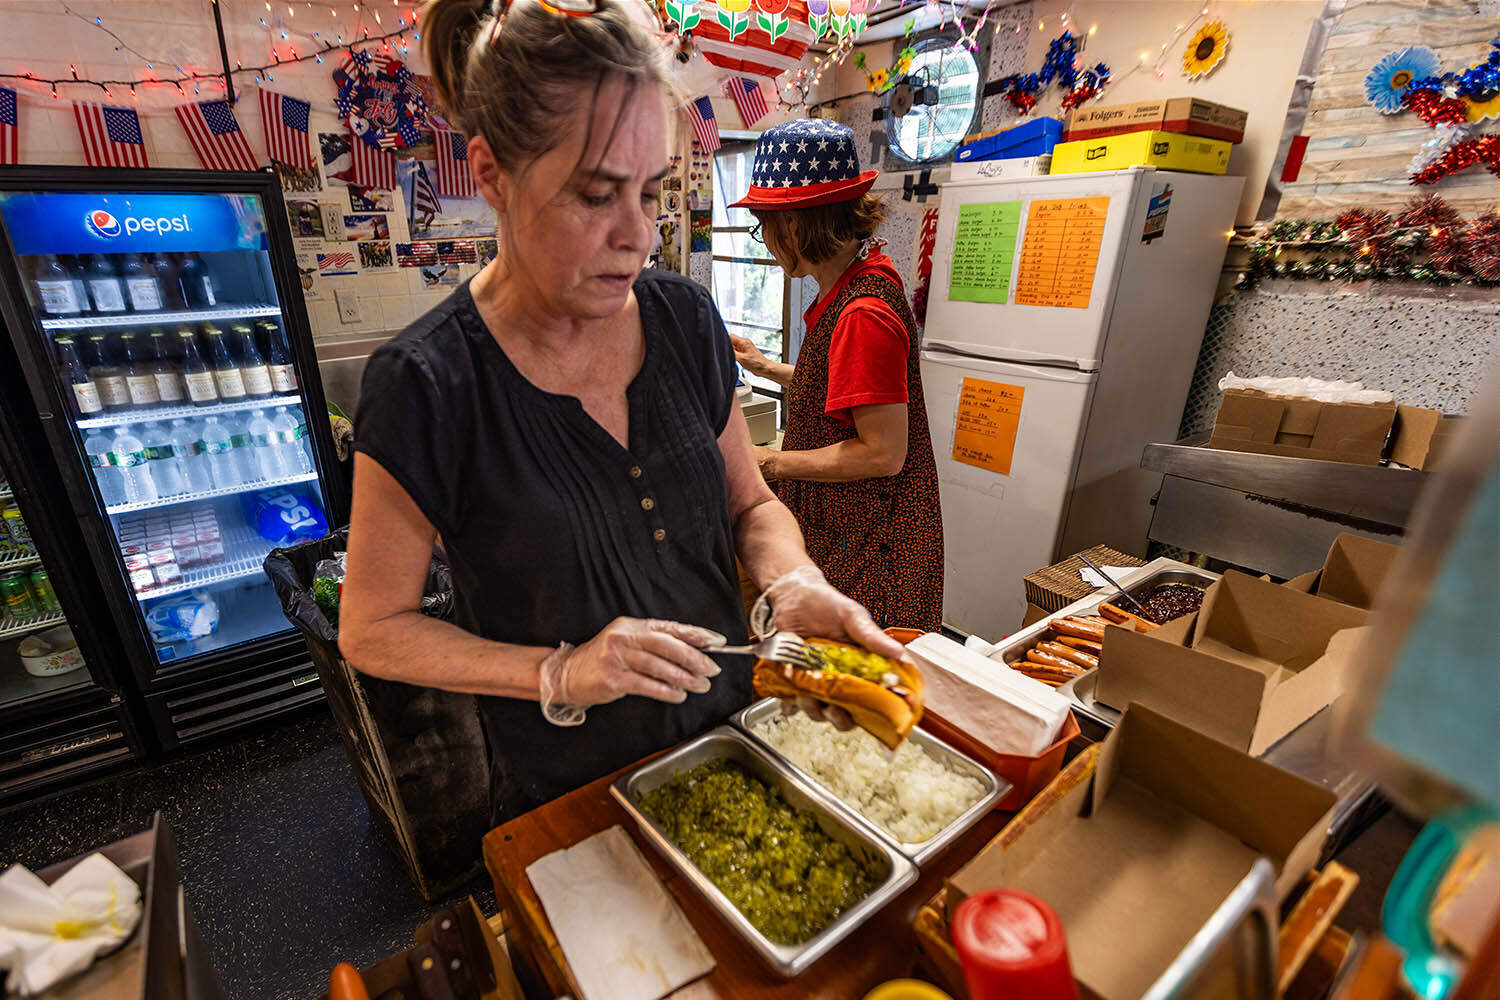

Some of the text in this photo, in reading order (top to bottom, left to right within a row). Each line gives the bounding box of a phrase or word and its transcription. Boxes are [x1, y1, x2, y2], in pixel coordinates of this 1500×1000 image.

[363, 99, 399, 127] July
[1090, 110, 1124, 121] Folgers
[124, 213, 190, 237] pepsi
